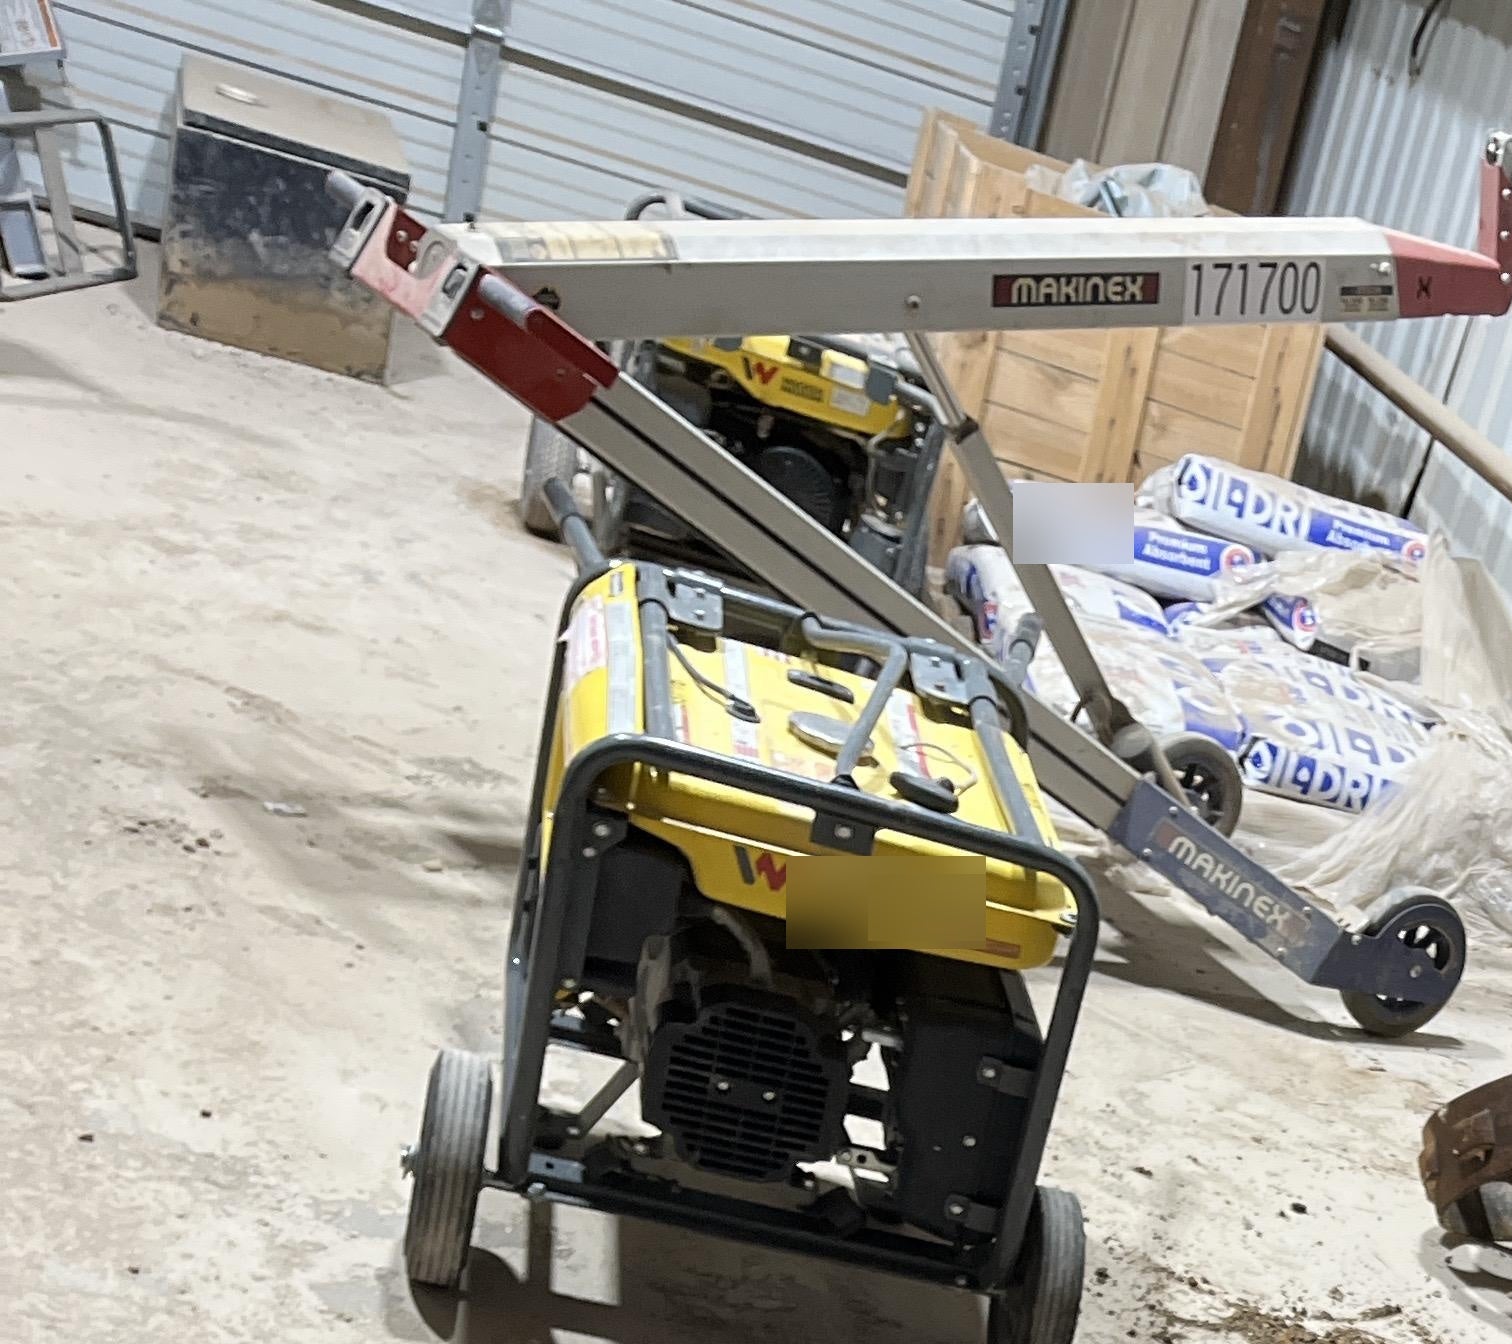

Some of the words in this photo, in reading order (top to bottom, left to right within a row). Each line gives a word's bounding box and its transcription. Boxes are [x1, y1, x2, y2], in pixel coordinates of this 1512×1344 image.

[1010, 274, 1145, 305] MAKINEX
[1190, 260, 1322, 317] 171700
[1167, 835, 1291, 932] MAKINEX
